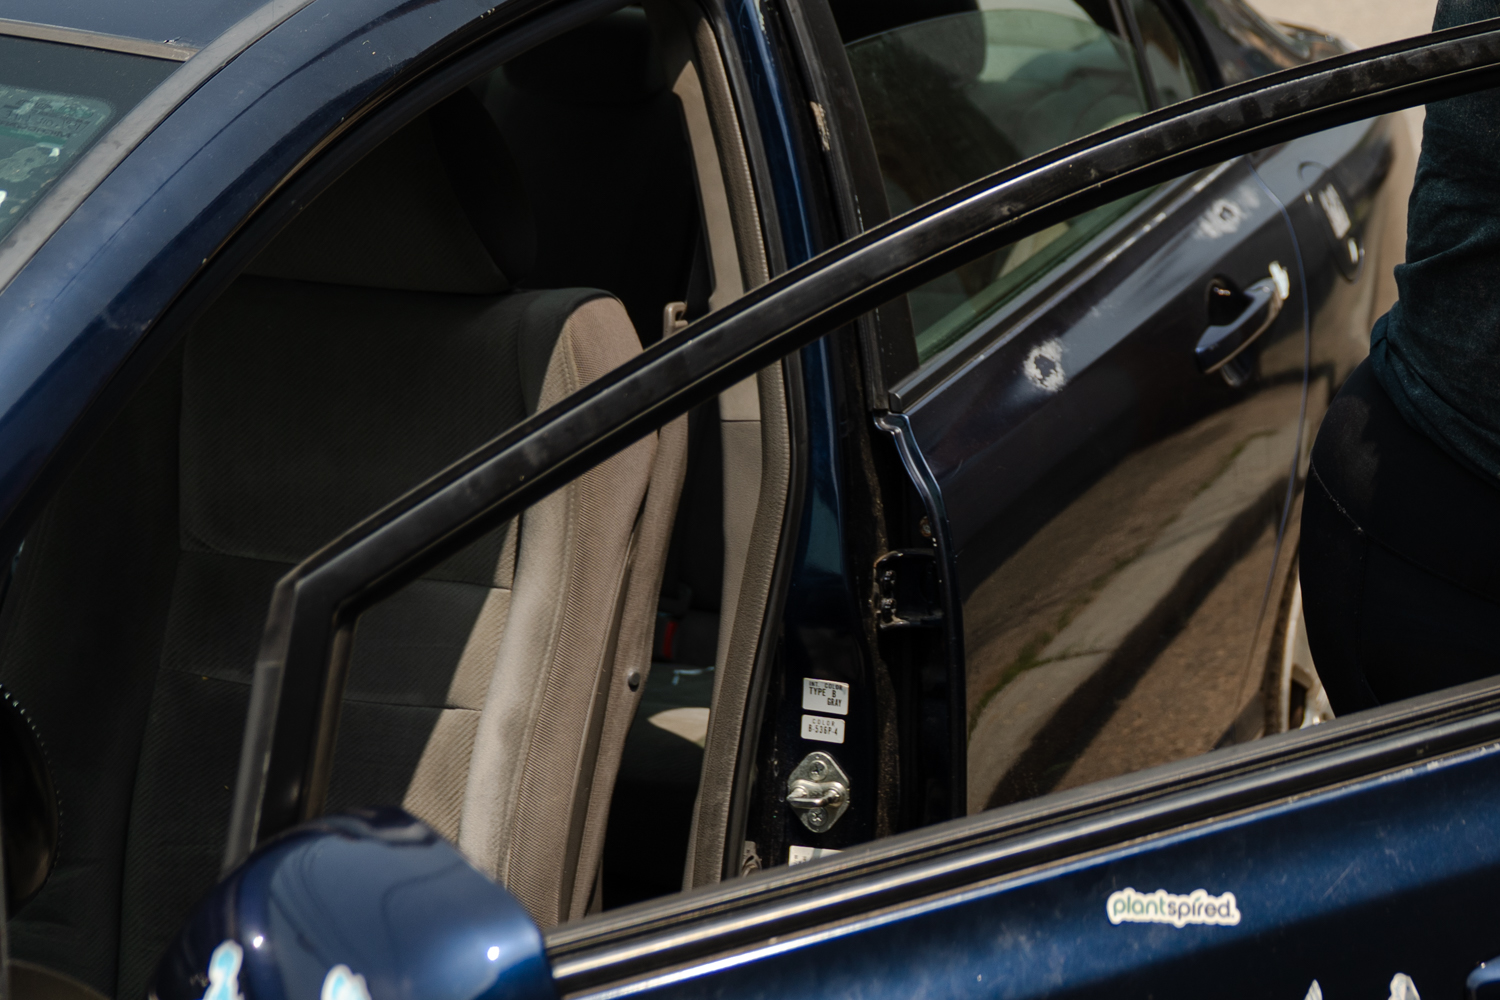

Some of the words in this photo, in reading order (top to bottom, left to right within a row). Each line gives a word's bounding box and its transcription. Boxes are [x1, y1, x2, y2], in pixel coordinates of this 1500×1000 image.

[809, 686, 826, 697] TYPE
[832, 689, 837, 698] B
[827, 698, 842, 707] GRAY
[812, 718, 835, 727] COLOR
